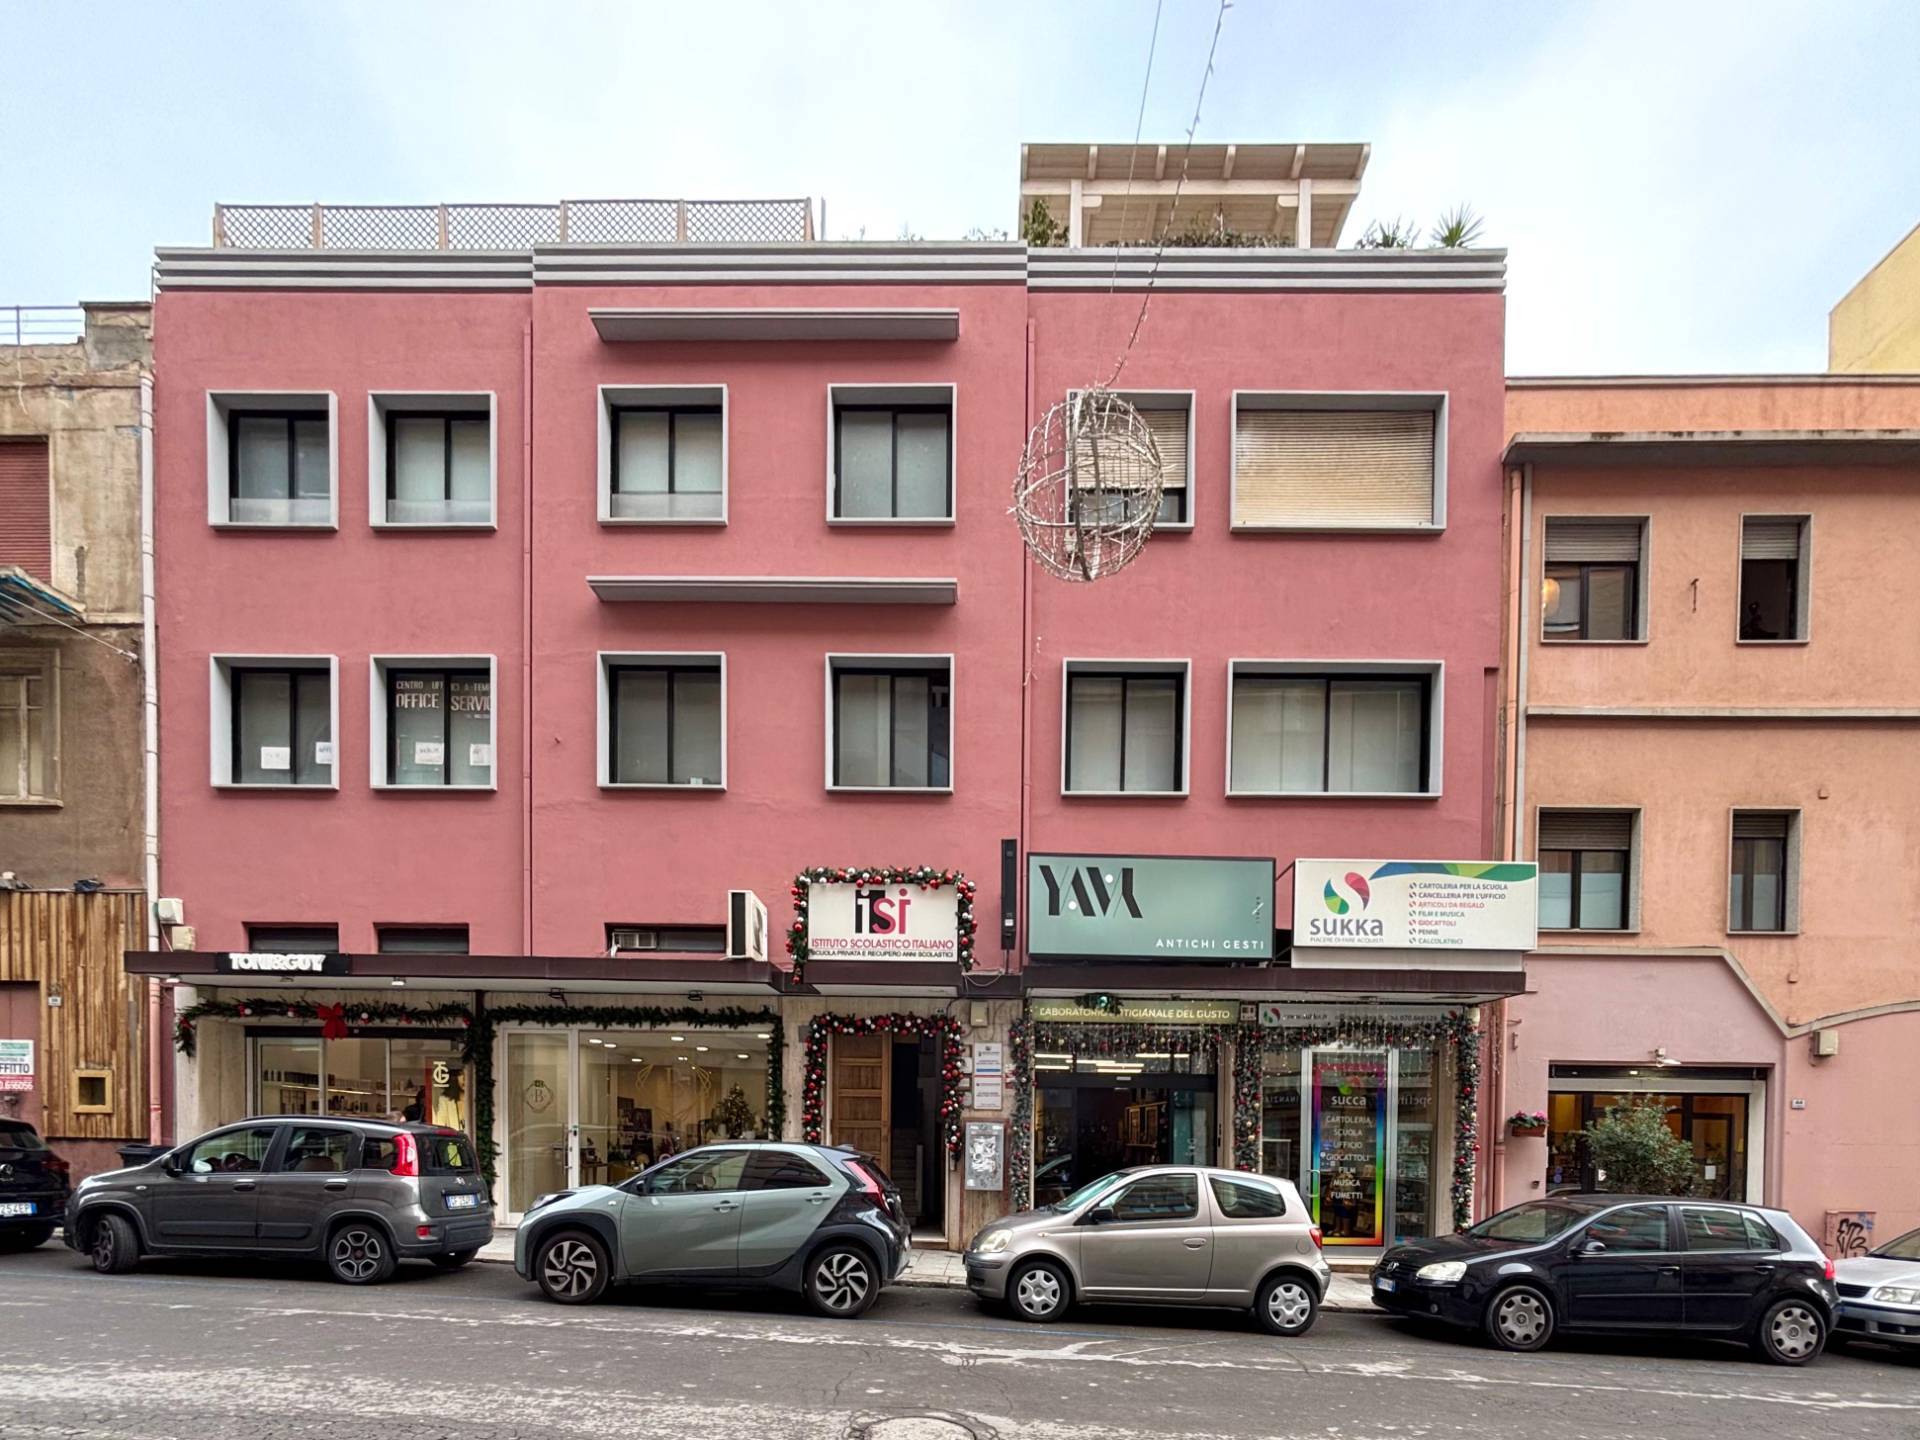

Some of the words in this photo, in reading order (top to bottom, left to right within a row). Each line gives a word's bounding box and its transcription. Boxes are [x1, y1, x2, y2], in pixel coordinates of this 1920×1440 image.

[396, 693, 440, 709] OFFICE
[812, 938, 848, 949] ISTITUTO
[850, 939, 911, 949] SCOLASTICO
[912, 940, 954, 950] ITALIANO
[1155, 938, 1215, 949] ANTICHI
[1223, 940, 1265, 950] GESTI
[229, 953, 326, 972] TONI&GUY
[1175, 1009, 1195, 1018] DEL
[1196, 1009, 1231, 1019] GUSTO
[1331, 1096, 1367, 1106] succa
[1326, 1116, 1371, 1124] CARTOLERIA
[1333, 1141, 1363, 1149] UFFICIO
[1326, 1153, 1369, 1161] GIOCATTOLI
[1333, 1179, 1361, 1187] MUSICA
